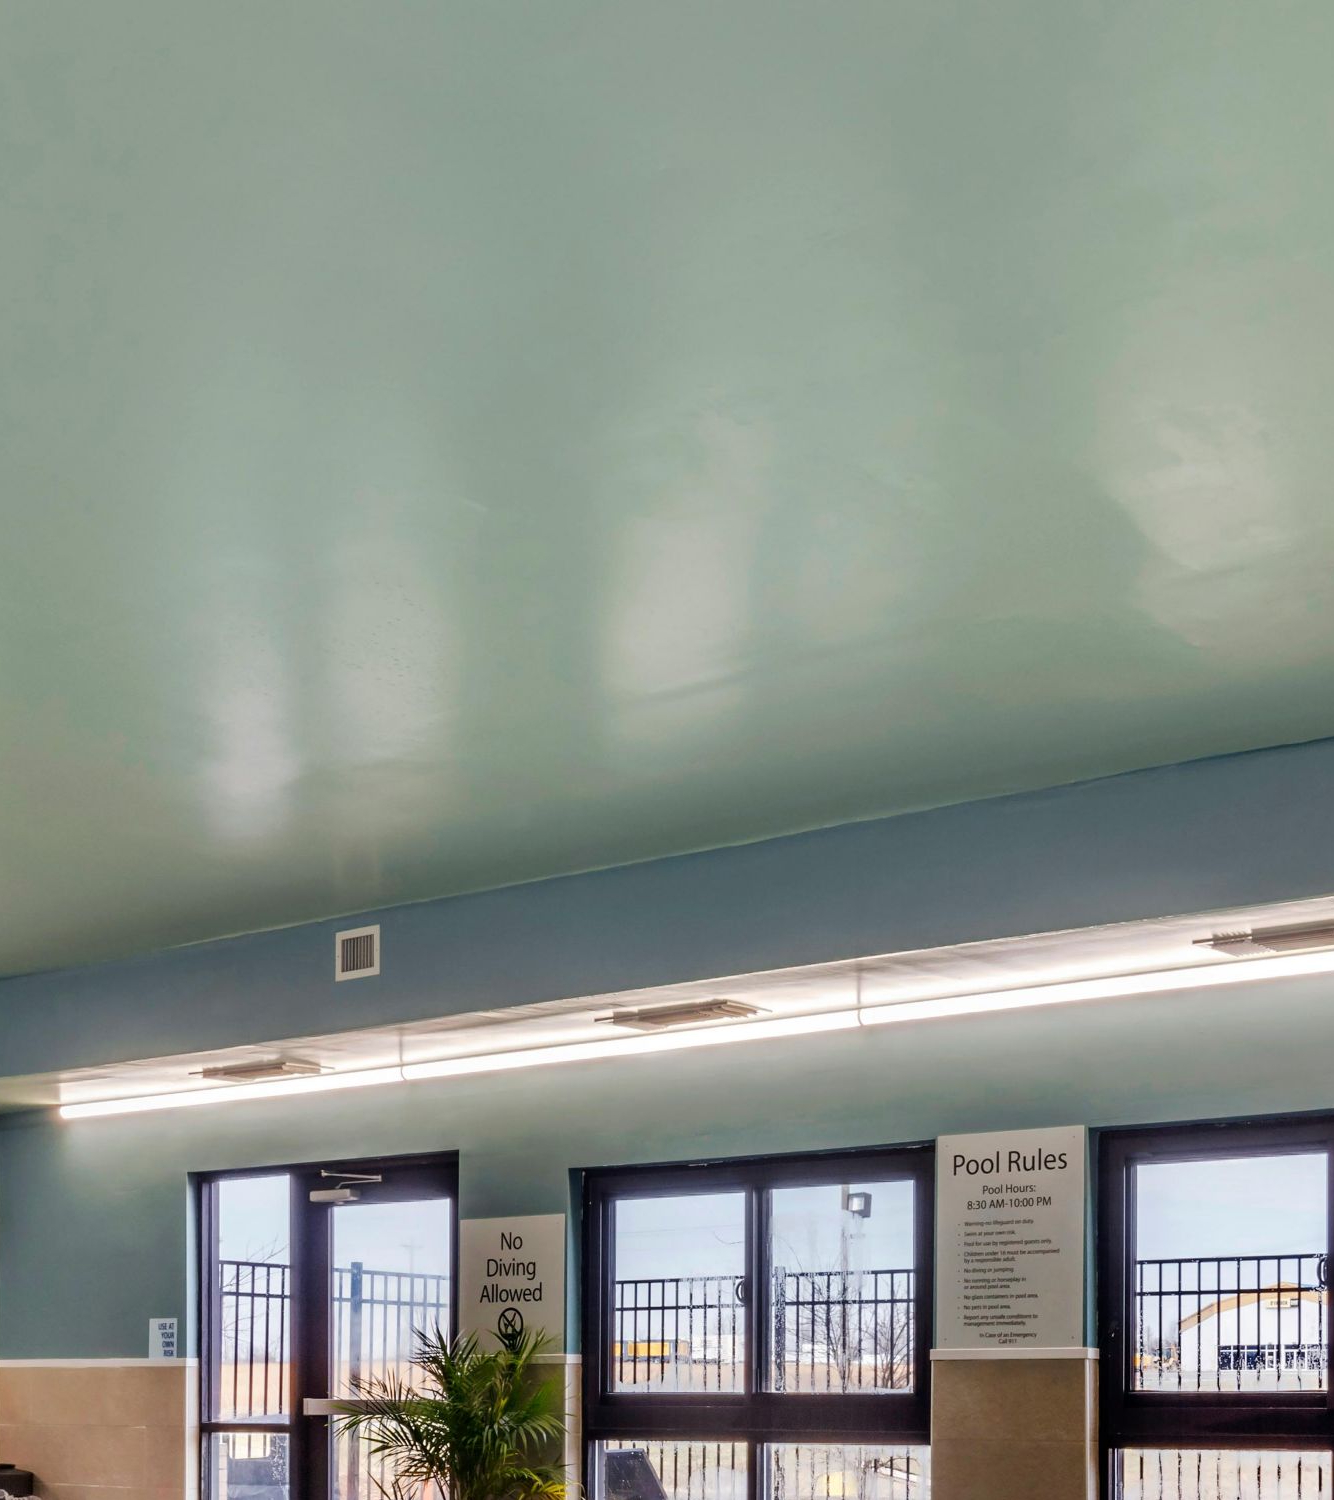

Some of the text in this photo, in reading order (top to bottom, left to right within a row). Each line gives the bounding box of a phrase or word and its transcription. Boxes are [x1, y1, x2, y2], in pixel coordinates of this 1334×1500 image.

[953, 1148, 1067, 1176] Pool Rules
[983, 1184, 1036, 1195] Pool Hours:
[967, 1200, 986, 1210] 8:30
[1036, 1197, 1051, 1206] PM
[501, 1232, 523, 1250] No
[487, 1258, 536, 1280] Diving
[480, 1282, 542, 1303] Allowed
